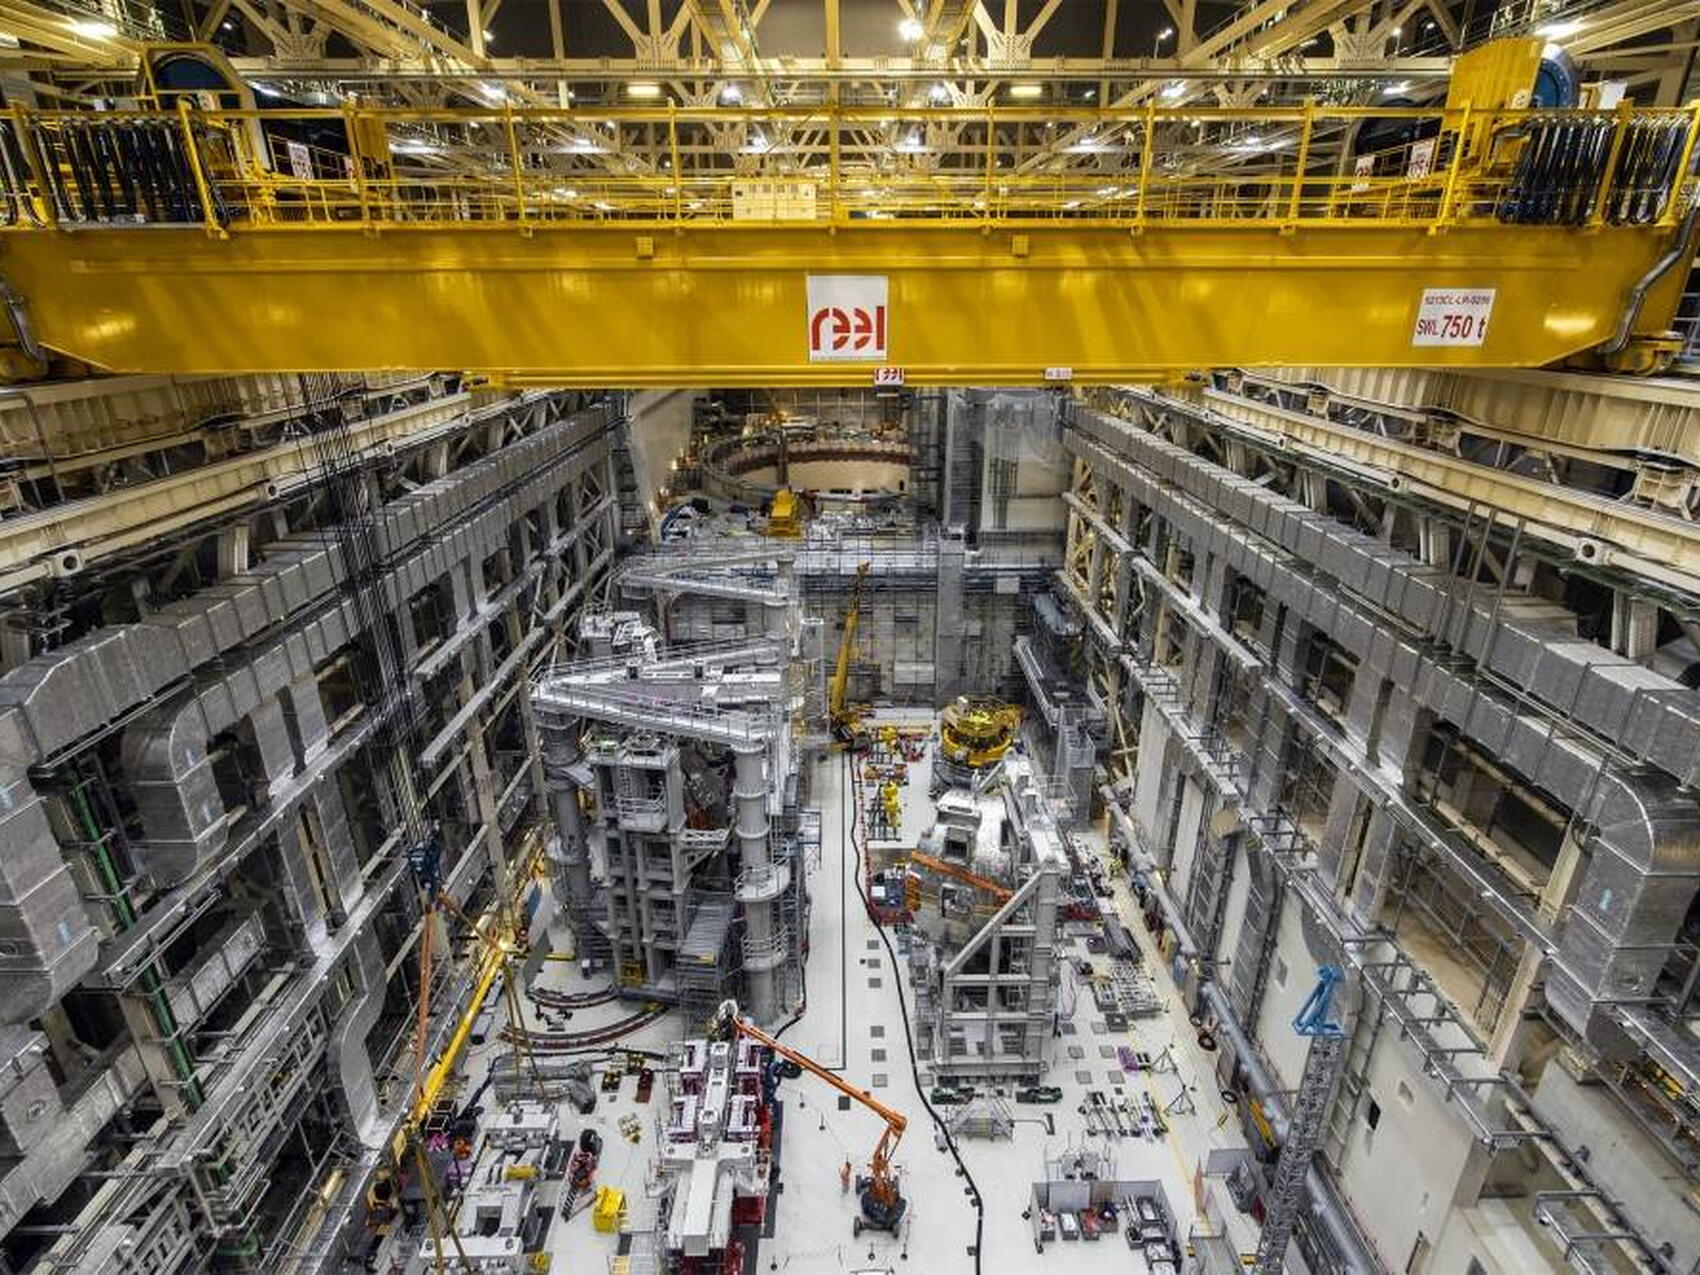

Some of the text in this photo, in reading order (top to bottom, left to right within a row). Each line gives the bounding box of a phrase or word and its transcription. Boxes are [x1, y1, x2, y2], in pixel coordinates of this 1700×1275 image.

[1416, 314, 1487, 338] SWL 750 t
